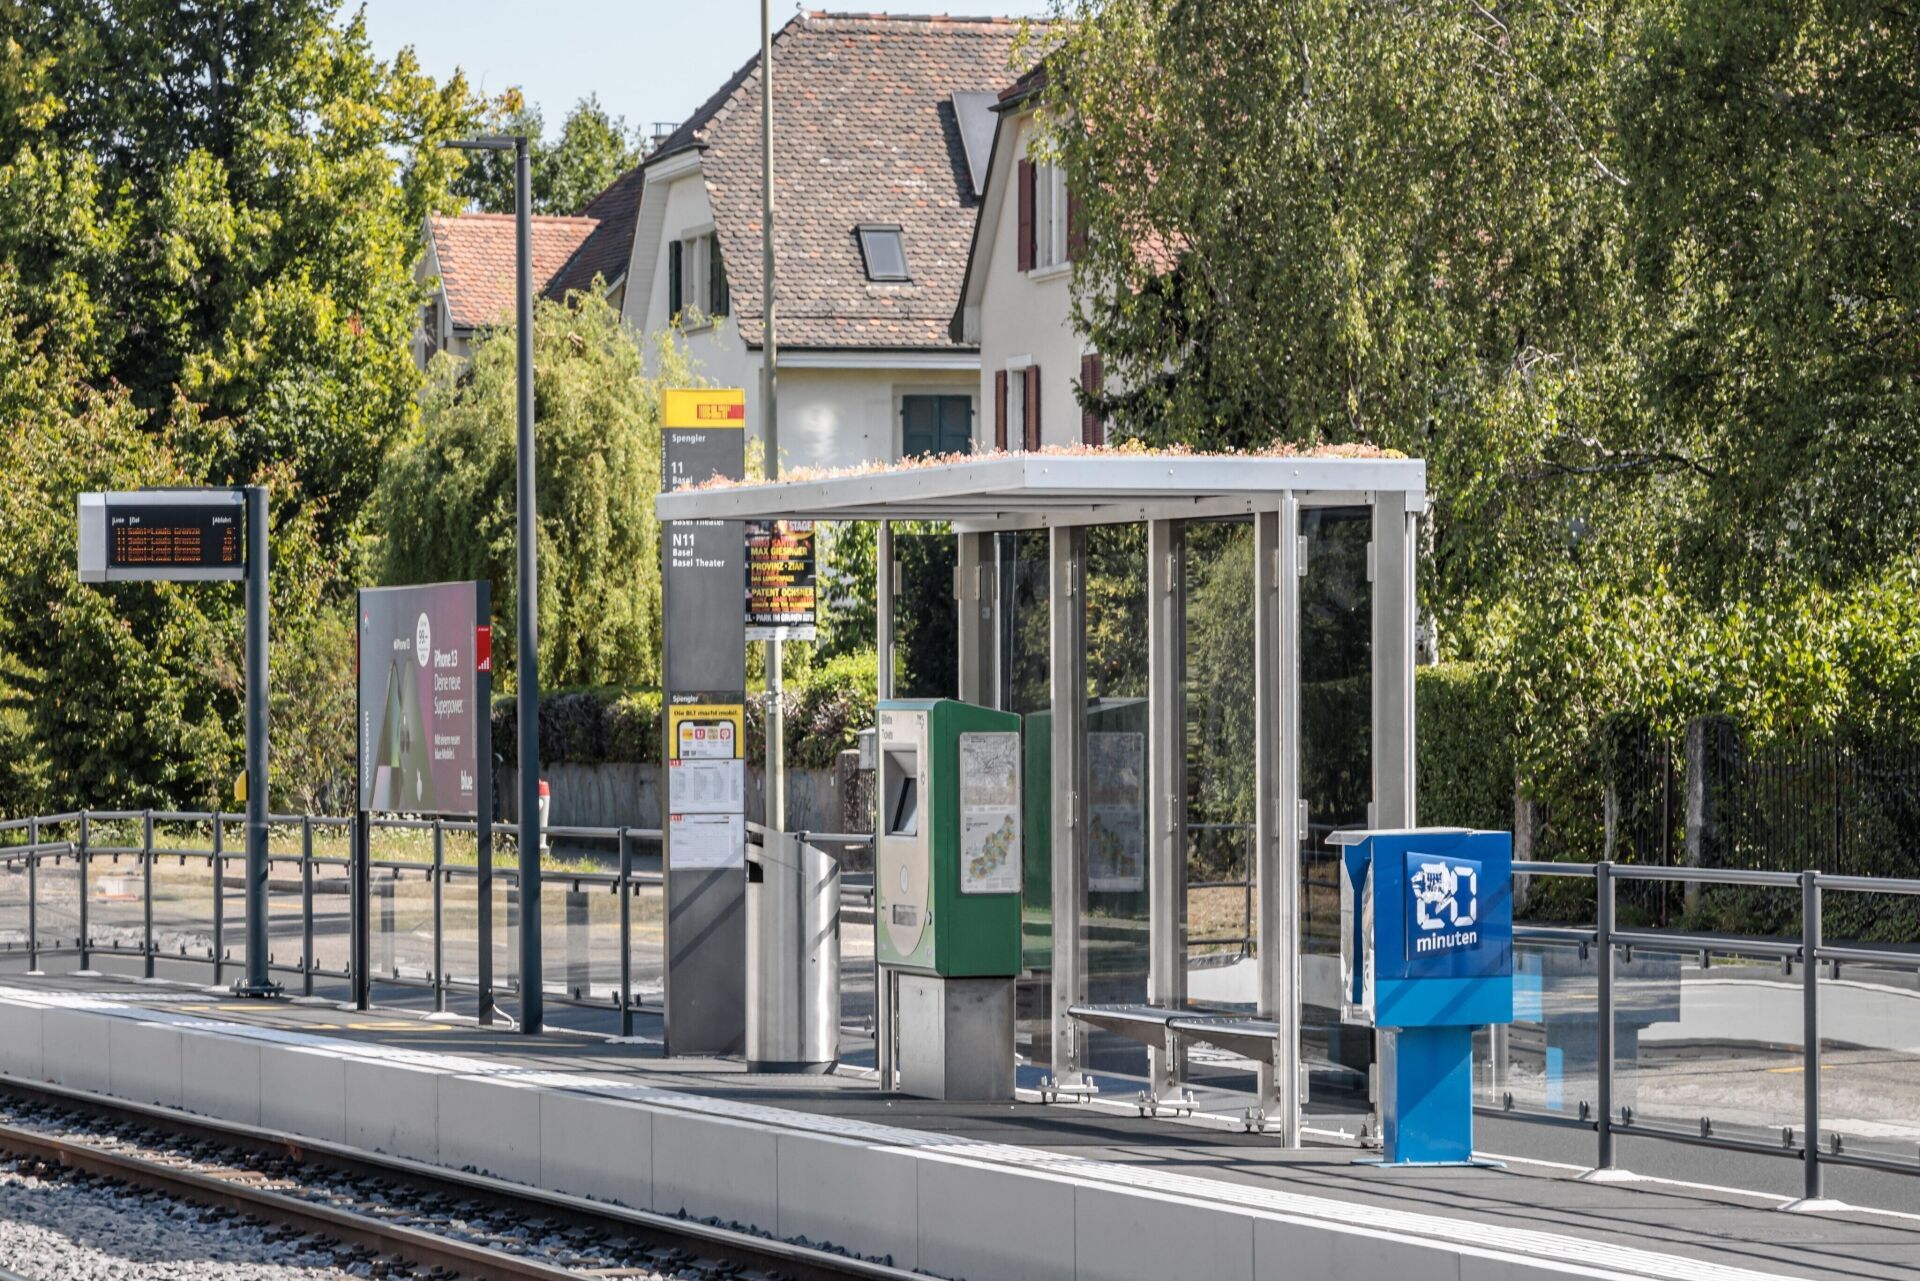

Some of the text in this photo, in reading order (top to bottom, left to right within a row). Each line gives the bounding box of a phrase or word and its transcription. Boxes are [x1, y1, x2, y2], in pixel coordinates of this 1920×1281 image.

[698, 404, 731, 420] BLT
[672, 434, 706, 444] Spengler
[671, 461, 683, 474] 11
[672, 475, 693, 484] Basel
[788, 521, 812, 531] STAGE
[672, 534, 695, 546] N11
[672, 548, 693, 556] Basel
[751, 547, 768, 556] MAX
[672, 559, 725, 567] Basel Theater
[751, 562, 805, 571] PROVINZ ZIAN
[752, 588, 779, 597] PATENT
[434, 649, 458, 668] iPhone 13
[434, 674, 461, 691] Deine neue
[672, 695, 699, 703] Spengler
[461, 770, 472, 790] blue
[1416, 931, 1477, 953] minuten
